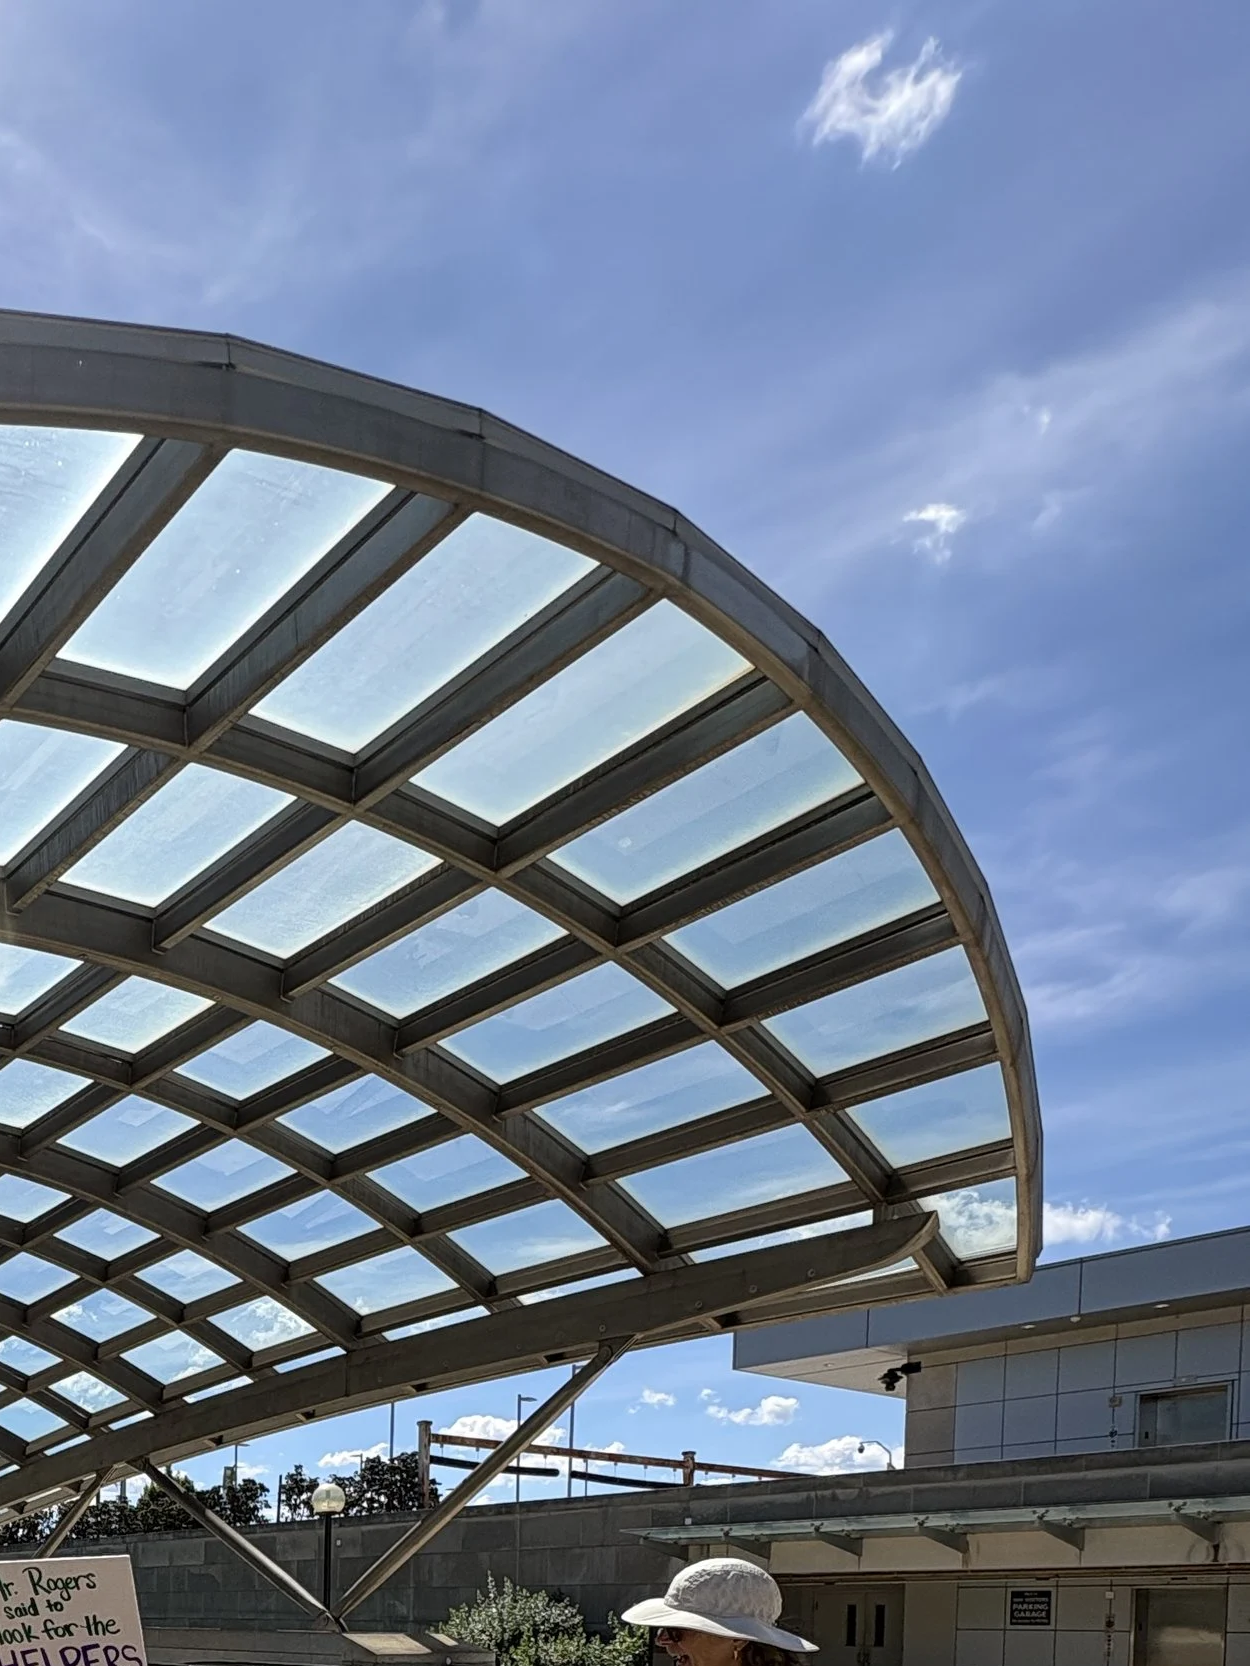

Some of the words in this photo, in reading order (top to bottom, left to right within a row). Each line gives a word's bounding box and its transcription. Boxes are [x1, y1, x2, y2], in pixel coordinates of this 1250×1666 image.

[22, 1566, 97, 1602] Rogers
[3, 1597, 39, 1620] said
[45, 1599, 64, 1612] to
[1013, 1610, 1047, 1618] GARAGE
[41, 1618, 80, 1641] for
[80, 1614, 121, 1636] the
